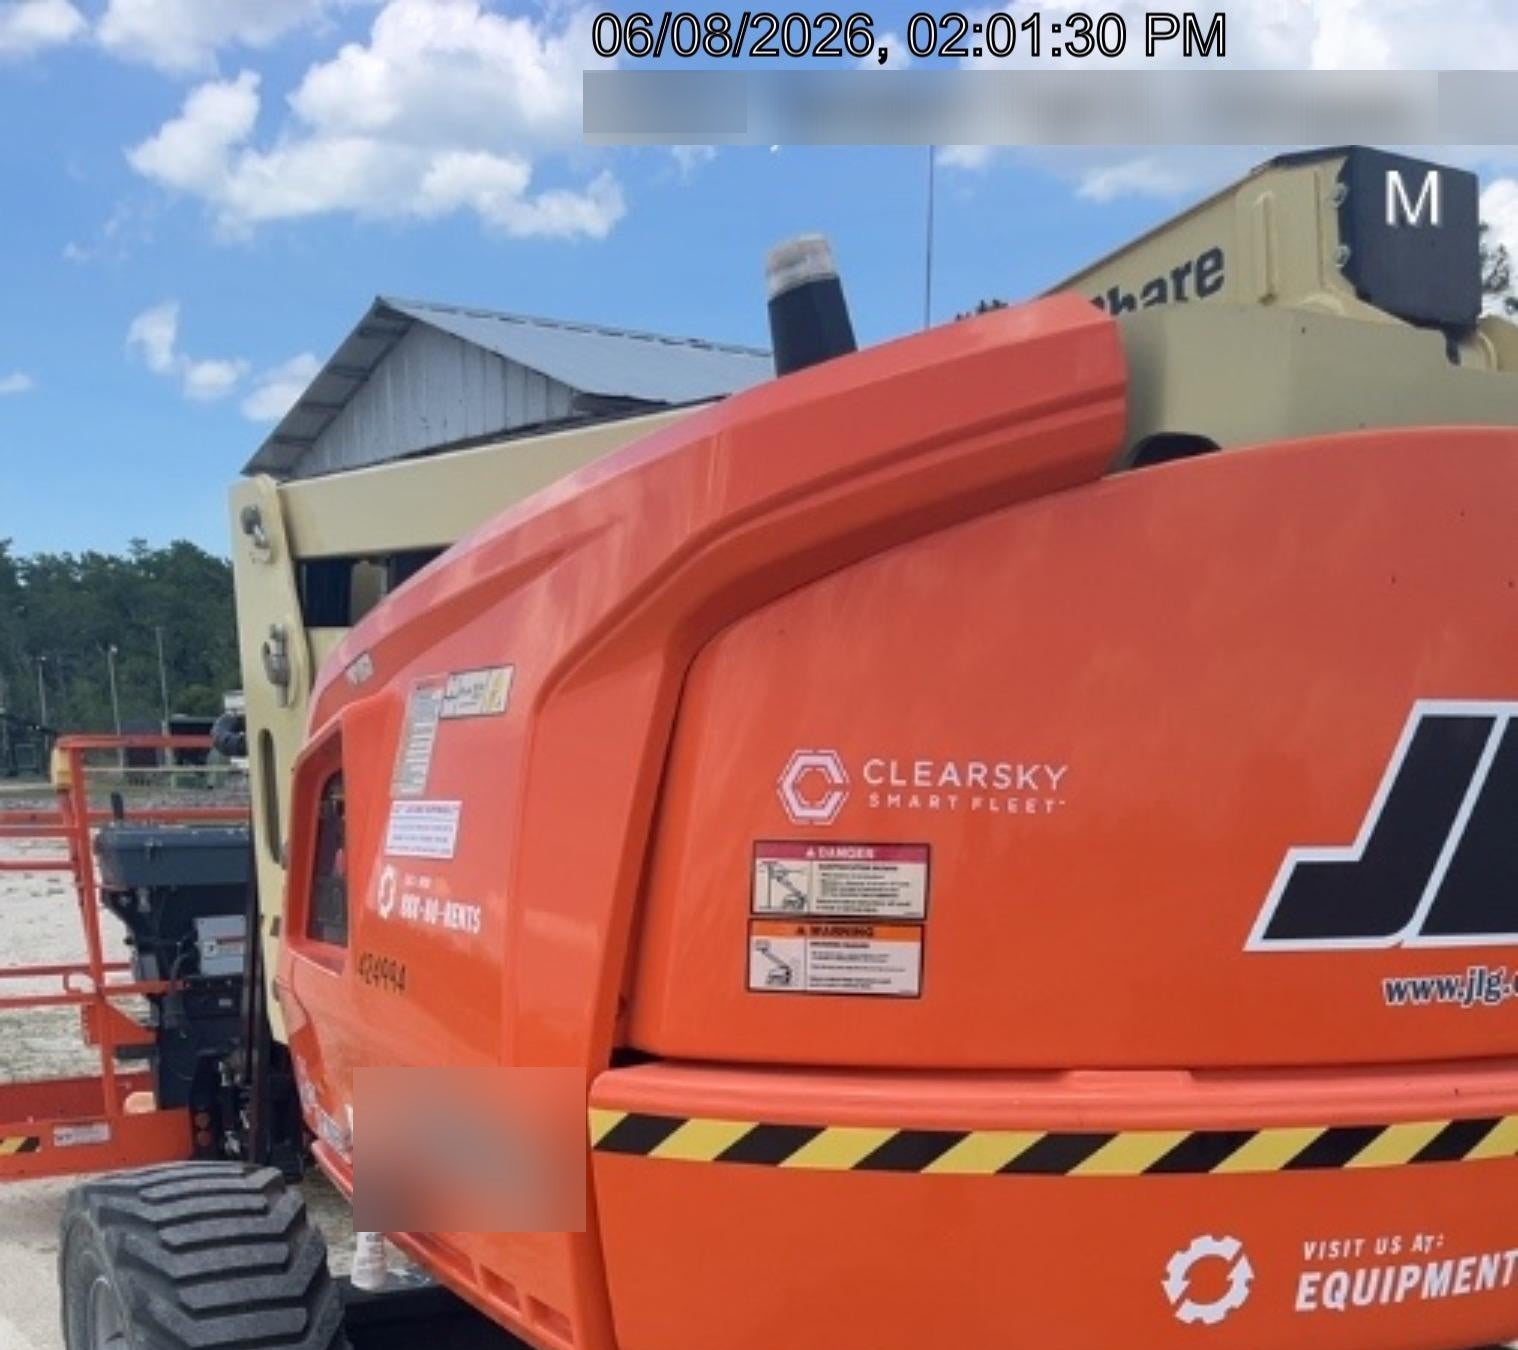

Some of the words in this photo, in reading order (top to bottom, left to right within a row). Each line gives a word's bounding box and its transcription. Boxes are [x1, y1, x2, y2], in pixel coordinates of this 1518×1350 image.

[863, 758, 1068, 791] CLEARSKY
[868, 793, 959, 810] SMART
[1304, 1238, 1366, 1261] VISIT
[1374, 1235, 1403, 1256] US
[1412, 1232, 1445, 1254] AT:
[1295, 1247, 1518, 1313] EQUIPMENT
